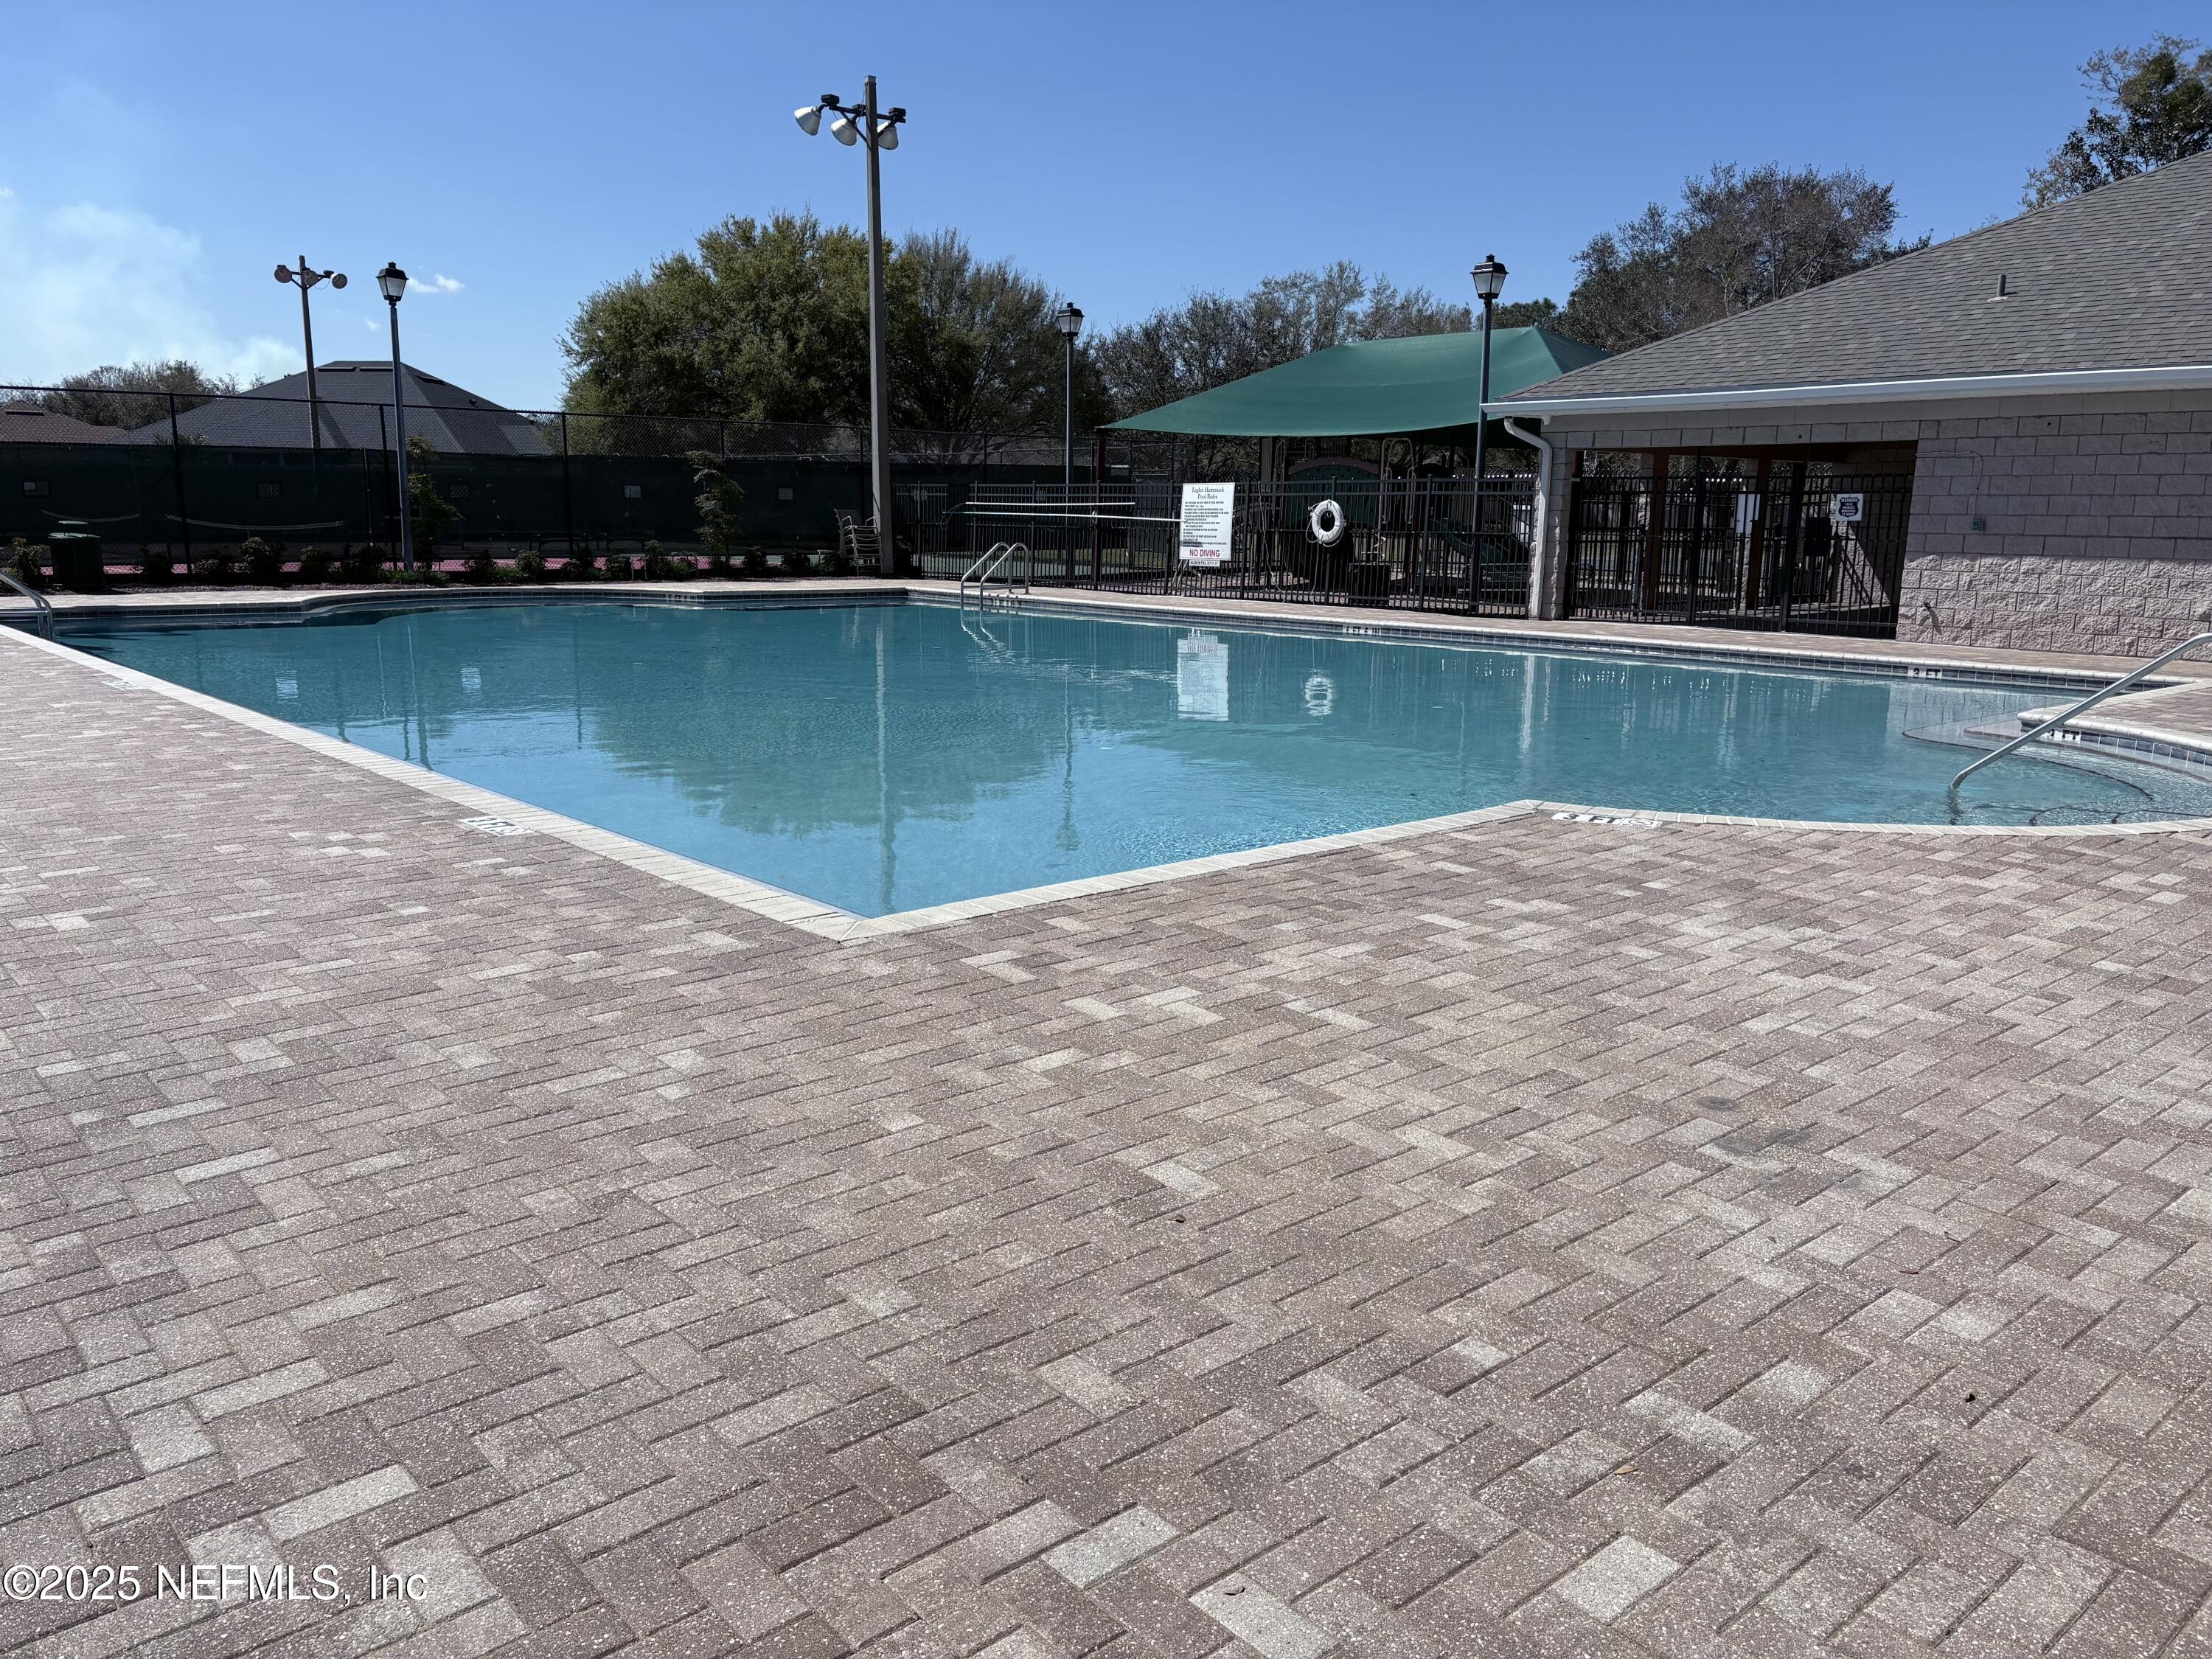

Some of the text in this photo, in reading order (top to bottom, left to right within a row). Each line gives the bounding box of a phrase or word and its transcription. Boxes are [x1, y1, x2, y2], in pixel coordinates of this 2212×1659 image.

[1189, 549, 1220, 557] NO DIVING
[1925, 668, 1941, 677] FT
[2062, 729, 2080, 740] FT
[1587, 815, 1623, 824] FT
